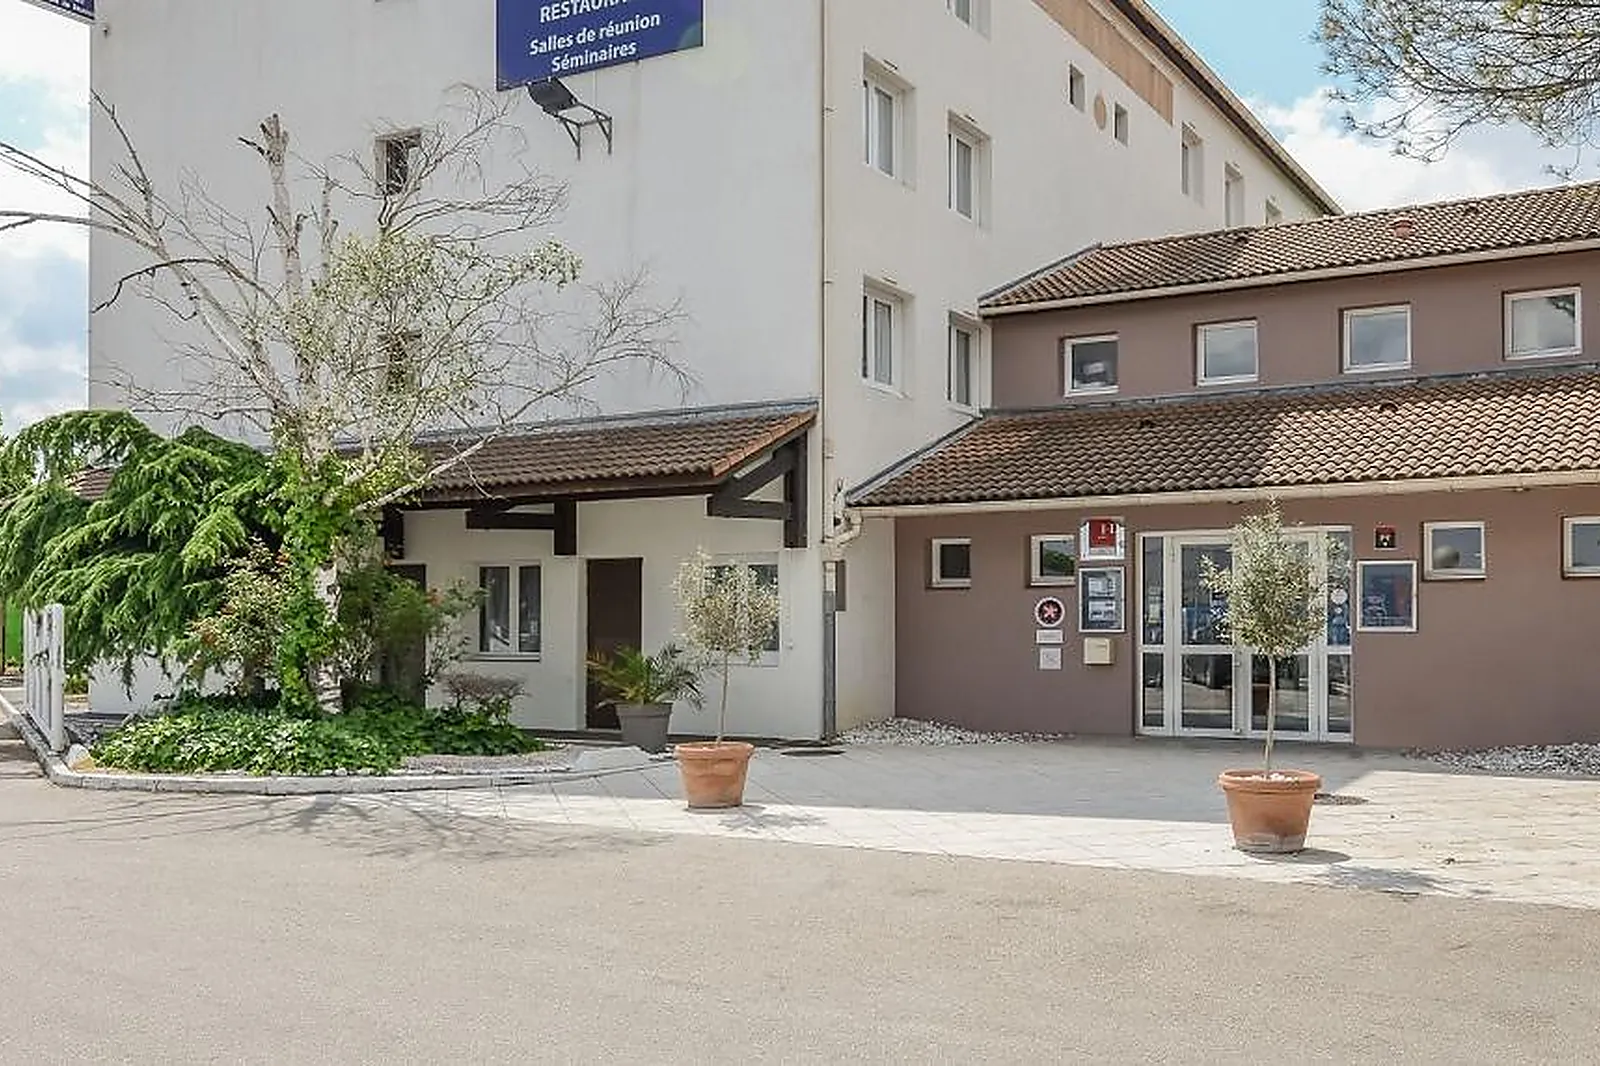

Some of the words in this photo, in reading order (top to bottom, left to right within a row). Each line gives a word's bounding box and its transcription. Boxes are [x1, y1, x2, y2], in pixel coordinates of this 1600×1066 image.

[539, 0, 628, 23] RESTAU
[529, 33, 574, 56] Salles
[576, 27, 596, 44] de
[599, 13, 661, 40] réunion
[551, 41, 637, 72] Séminaires
